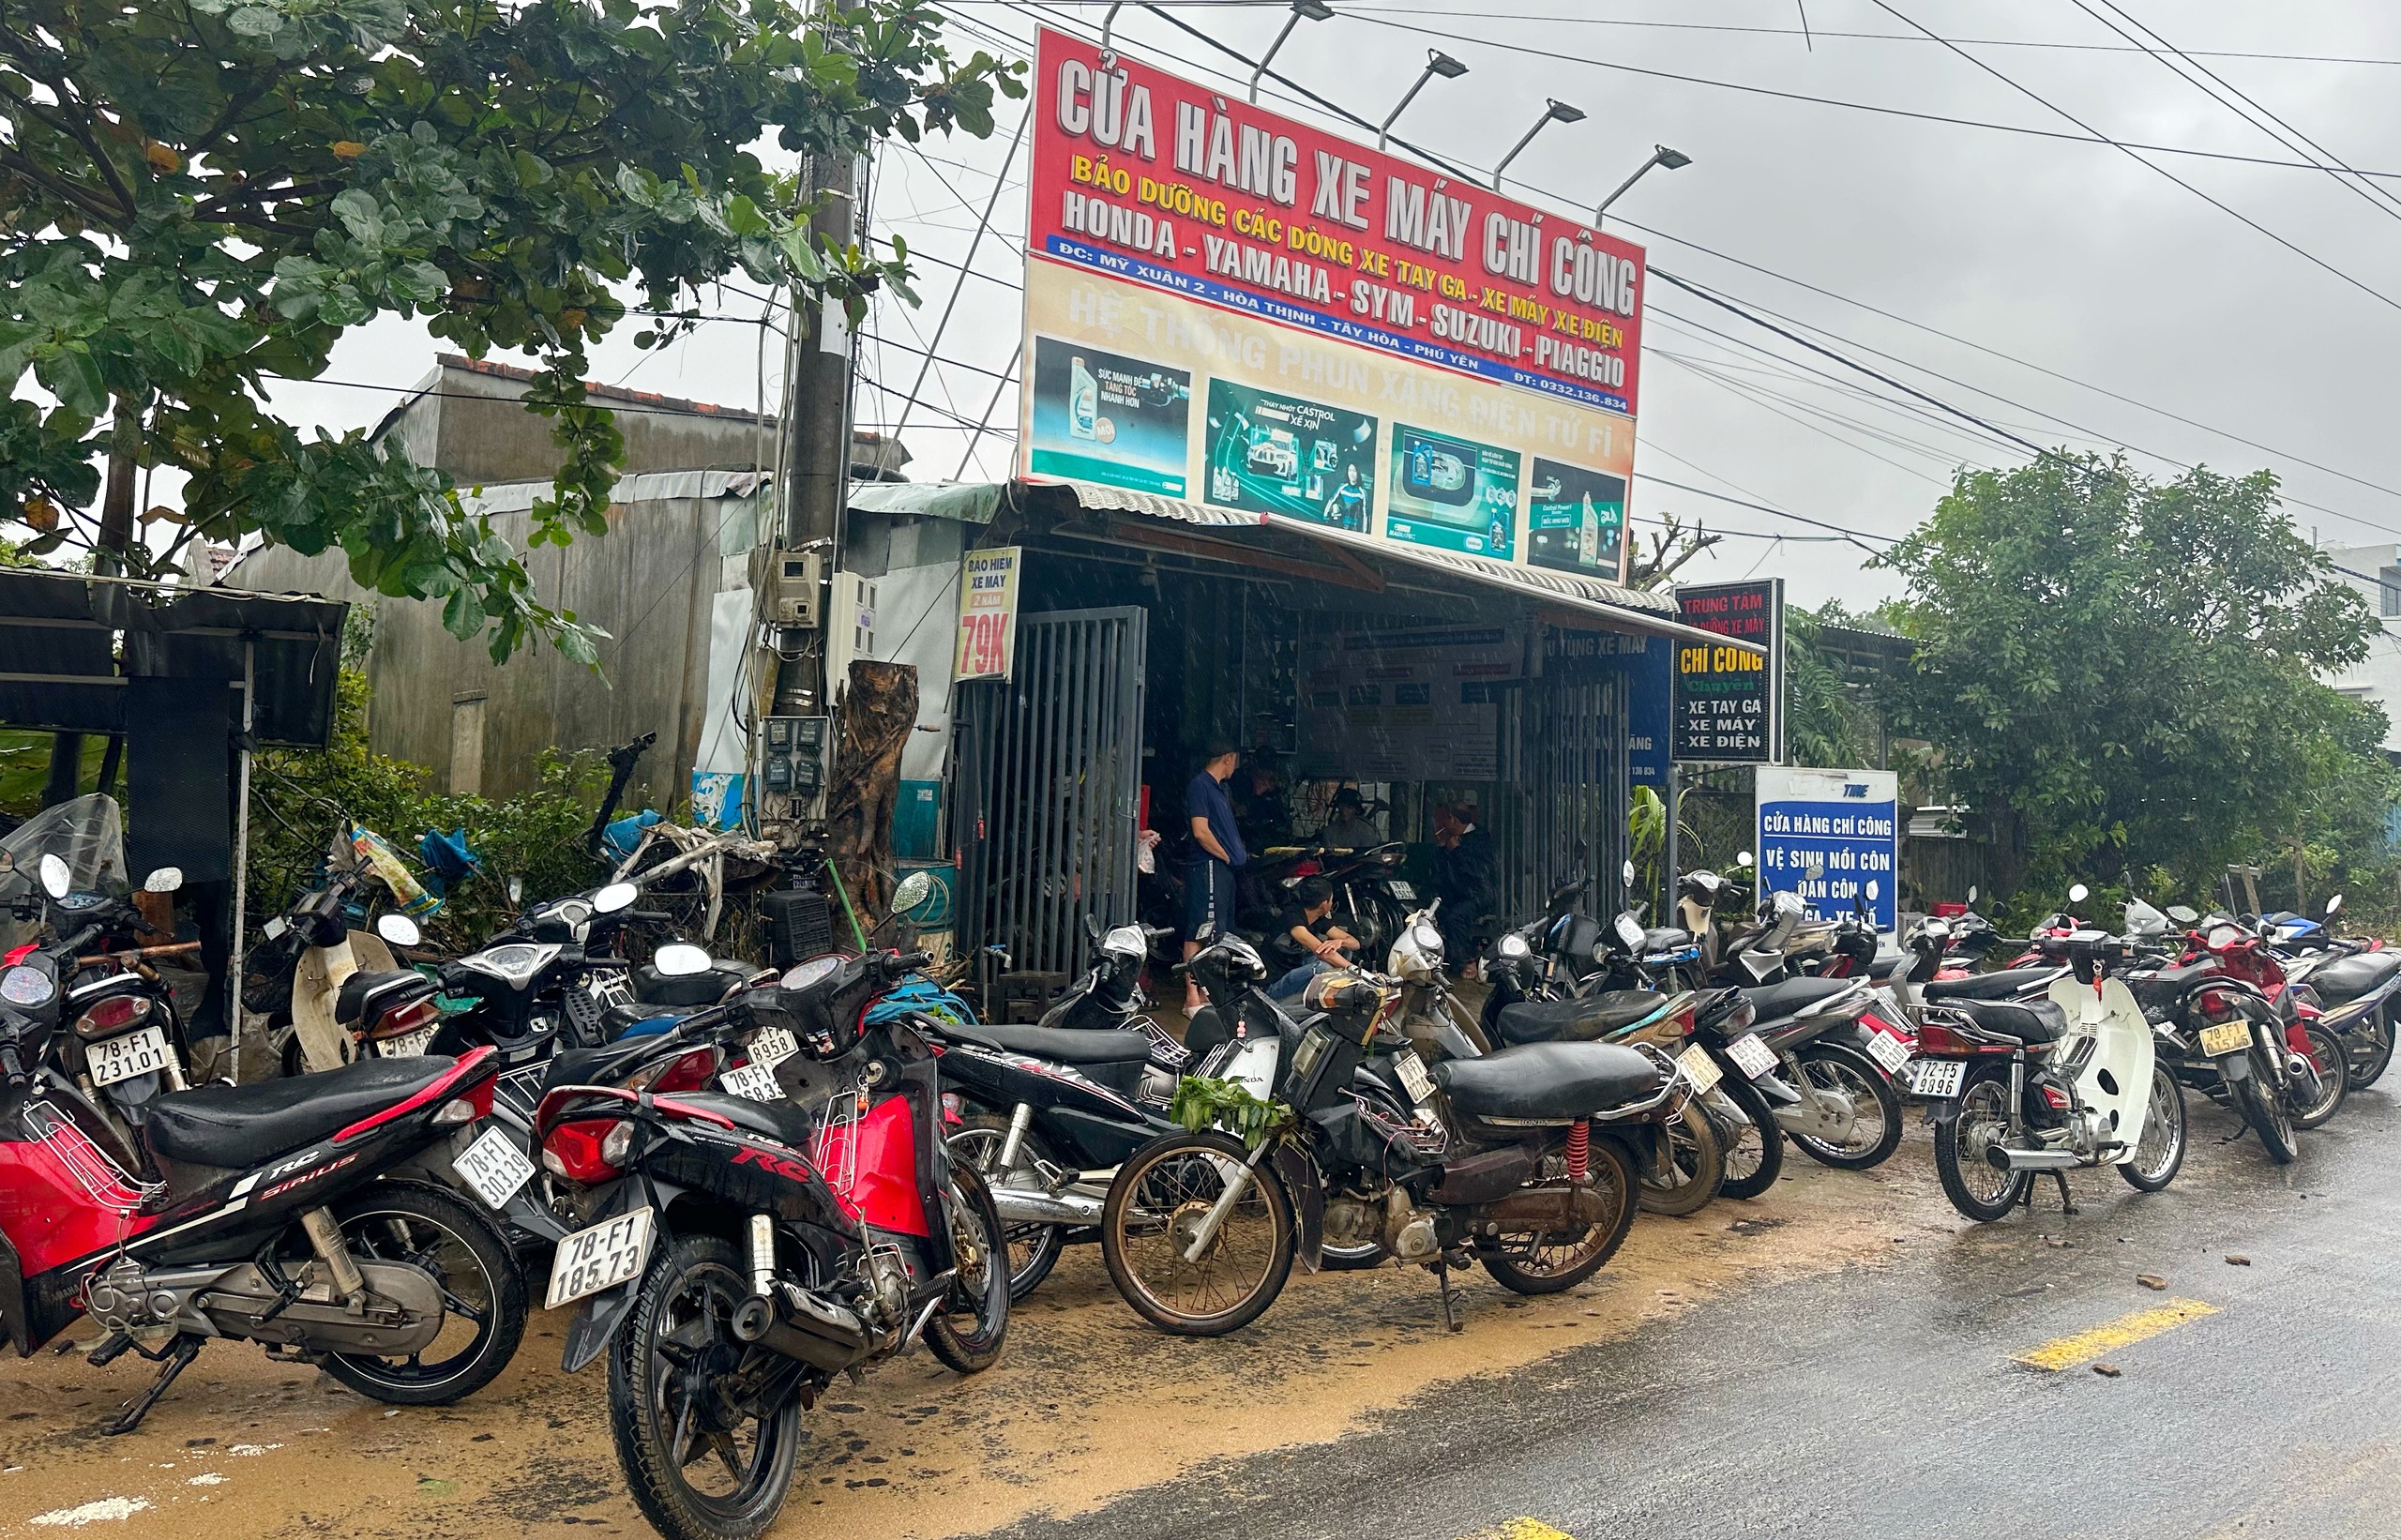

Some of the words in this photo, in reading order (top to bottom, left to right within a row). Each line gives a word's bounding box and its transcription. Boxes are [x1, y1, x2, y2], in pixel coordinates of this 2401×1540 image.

[1057, 49, 1156, 160] CỬA
[1174, 95, 1298, 206] HÀNG
[1311, 149, 1371, 230] XE
[1385, 178, 1472, 261] MÁY
[1484, 211, 1544, 286] CHÍ
[1550, 228, 1637, 317] CÔNG
[1071, 153, 1130, 196] BẢO
[1138, 175, 1226, 226] DƯỠNG
[1232, 206, 1283, 244] CÁC
[1288, 223, 1354, 267] DÒNG
[1358, 247, 1390, 278] XE
[1397, 259, 1438, 293] TAY
[1440, 274, 1467, 301] GA
[1479, 286, 1506, 314] XE
[1509, 294, 1549, 326] MÁY
[1553, 310, 1579, 336] XE
[1581, 318, 1623, 351] ĐIỆN
[1063, 189, 1177, 260] HONDA
[1203, 233, 1332, 306] YAMAHA
[1351, 279, 1414, 328] SYM
[1430, 304, 1522, 360] SUZUKI
[1534, 334, 1625, 389] PIAGGIO
[1059, 242, 1093, 262] ĐC:
[1099, 253, 1129, 271] MỸ
[1137, 264, 1187, 289] XUÂN
[1193, 282, 1205, 294] 2
[1223, 290, 1260, 310] HÒA
[1264, 302, 1316, 325] THỊNH
[1331, 321, 1363, 340] TÂY
[1367, 332, 1399, 349] HÒA
[1414, 343, 1444, 360] PHÚ
[1449, 353, 1479, 370] YÊN
[1514, 372, 1536, 386] ĐT:
[1540, 380, 1627, 411] 0332.136.834
[1068, 288, 1123, 340] HỆ
[1140, 306, 1266, 370] THỐNG
[1278, 344, 1368, 396] PHUN
[1469, 396, 1535, 440] ĐIỆN
[1546, 410, 1581, 448] TỬ
[1296, 405, 1336, 422] CASTROL
[969, 556, 988, 573] BẢO
[972, 576, 983, 589] XE
[985, 573, 1006, 588] MÁY
[974, 596, 980, 606] 2
[1684, 596, 1729, 614] TRUNG
[1732, 591, 1763, 611] TÂM
[1731, 618, 1743, 634] XE
[1744, 614, 1764, 633] MÁY
[961, 612, 1009, 674] 79K
[1597, 637, 1614, 656] XE
[1681, 643, 1708, 673] CHÍ
[1688, 677, 1755, 694] Chuyên
[1688, 701, 1706, 714] XE
[1711, 701, 1738, 714] TAY
[1742, 699, 1761, 714] GA
[1688, 719, 1711, 731] XE
[1716, 717, 1757, 731] MÁY
[1629, 734, 1652, 750] ÃNG
[1688, 736, 1710, 747] XE
[1716, 732, 1760, 750] ĐIỆN
[1843, 784, 1869, 797] TIRE
[1764, 810, 1789, 832] CỬA
[1794, 814, 1830, 834] HÀNG
[1833, 815, 1855, 835] CHÍ
[1857, 816, 1892, 836] CÔNG
[1766, 846, 1784, 870] VỆ
[1789, 851, 1824, 868] SINH
[1860, 851, 1890, 870] CÔN
[1831, 878, 1858, 898] CÔN
[2207, 1023, 2240, 1041] 78-F1
[98, 1033, 152, 1063] 78-F1
[752, 1036, 789, 1061] 8958
[1732, 1038, 1759, 1060] 69-E1
[1871, 1034, 1894, 1057] 78-F1
[96, 1048, 164, 1081] 231.01
[1680, 1049, 1704, 1074] 78-F1
[1741, 1049, 1775, 1075] 051.86
[1882, 1044, 1908, 1071] 143.07
[730, 1064, 770, 1090] 78-F1
[1399, 1059, 1422, 1082] 78-F1
[1923, 1062, 1958, 1079] 72-F5
[1409, 1077, 1434, 1100] 072.0
[1919, 1079, 1954, 1095] 9896
[463, 1137, 507, 1180] 78-F1
[259, 1152, 360, 1201] SIRIUS
[480, 1153, 529, 1204] 303.39
[571, 1218, 634, 1266] 78-F1
[556, 1245, 640, 1303] 185.73
